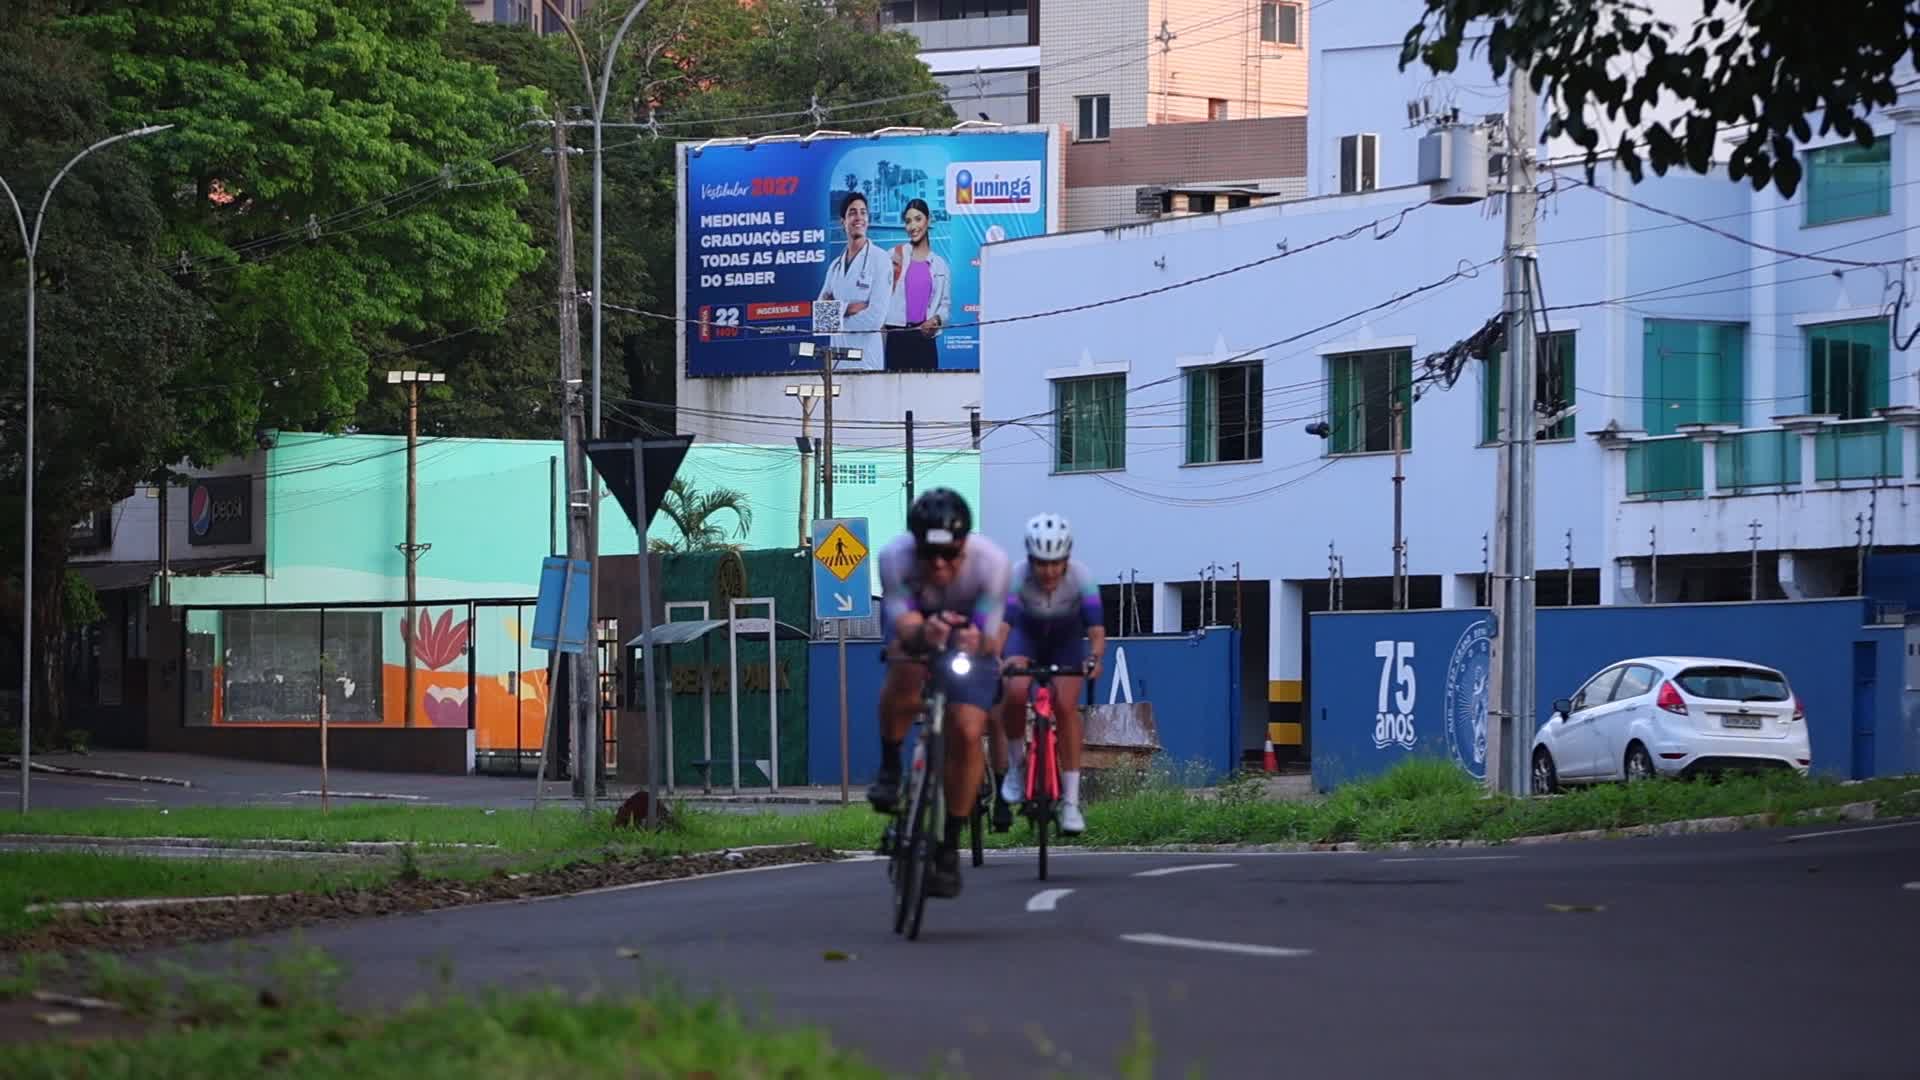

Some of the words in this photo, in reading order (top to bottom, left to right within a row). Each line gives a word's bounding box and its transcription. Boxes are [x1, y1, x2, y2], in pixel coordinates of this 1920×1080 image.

[701, 181, 750, 200] Vestibular
[752, 176, 799, 196] 2027
[974, 175, 1031, 199] uningá
[701, 212, 771, 228] MEDICINA
[774, 211, 785, 225] E
[701, 229, 800, 248] GRADUAÇÕES
[803, 229, 824, 243] EM
[700, 252, 749, 268] TODAS
[752, 251, 772, 265] AS
[775, 249, 826, 265] ÁREAS
[701, 274, 722, 287] DO
[725, 271, 775, 286] SABER
[715, 307, 739, 326] 22
[212, 495, 243, 525] pepsi
[1375, 640, 1416, 714] 75
[1375, 712, 1415, 742] anos
